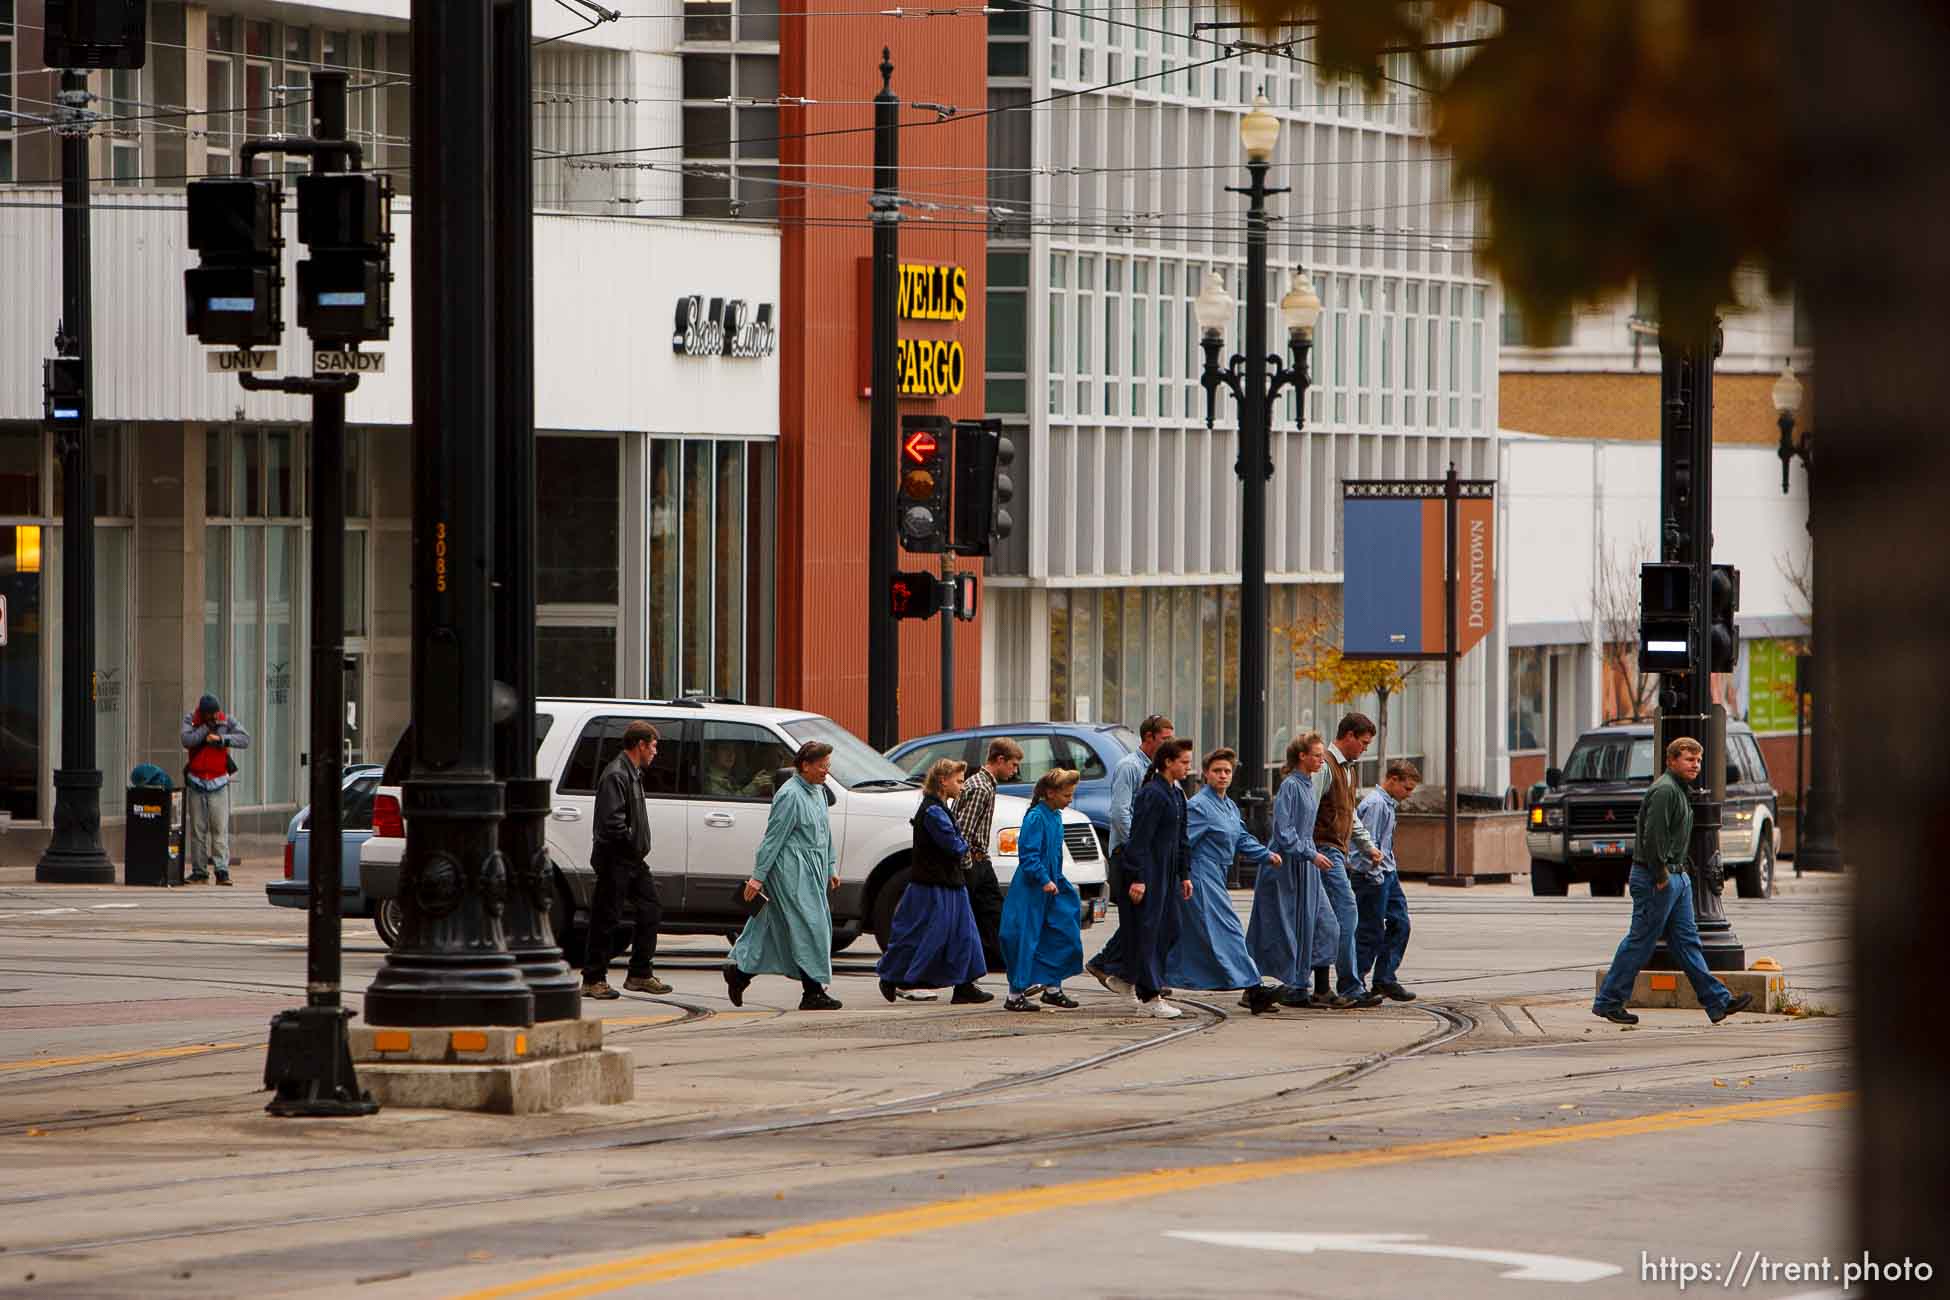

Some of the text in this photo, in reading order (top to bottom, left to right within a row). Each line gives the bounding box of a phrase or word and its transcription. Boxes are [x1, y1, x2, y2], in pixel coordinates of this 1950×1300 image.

[731, 302, 775, 357] Lunch
[219, 352, 265, 369] UNIV
[316, 352, 384, 370] SANDY
[436, 522, 447, 592] 3085
[1469, 519, 1485, 628] DOWNTOWN
